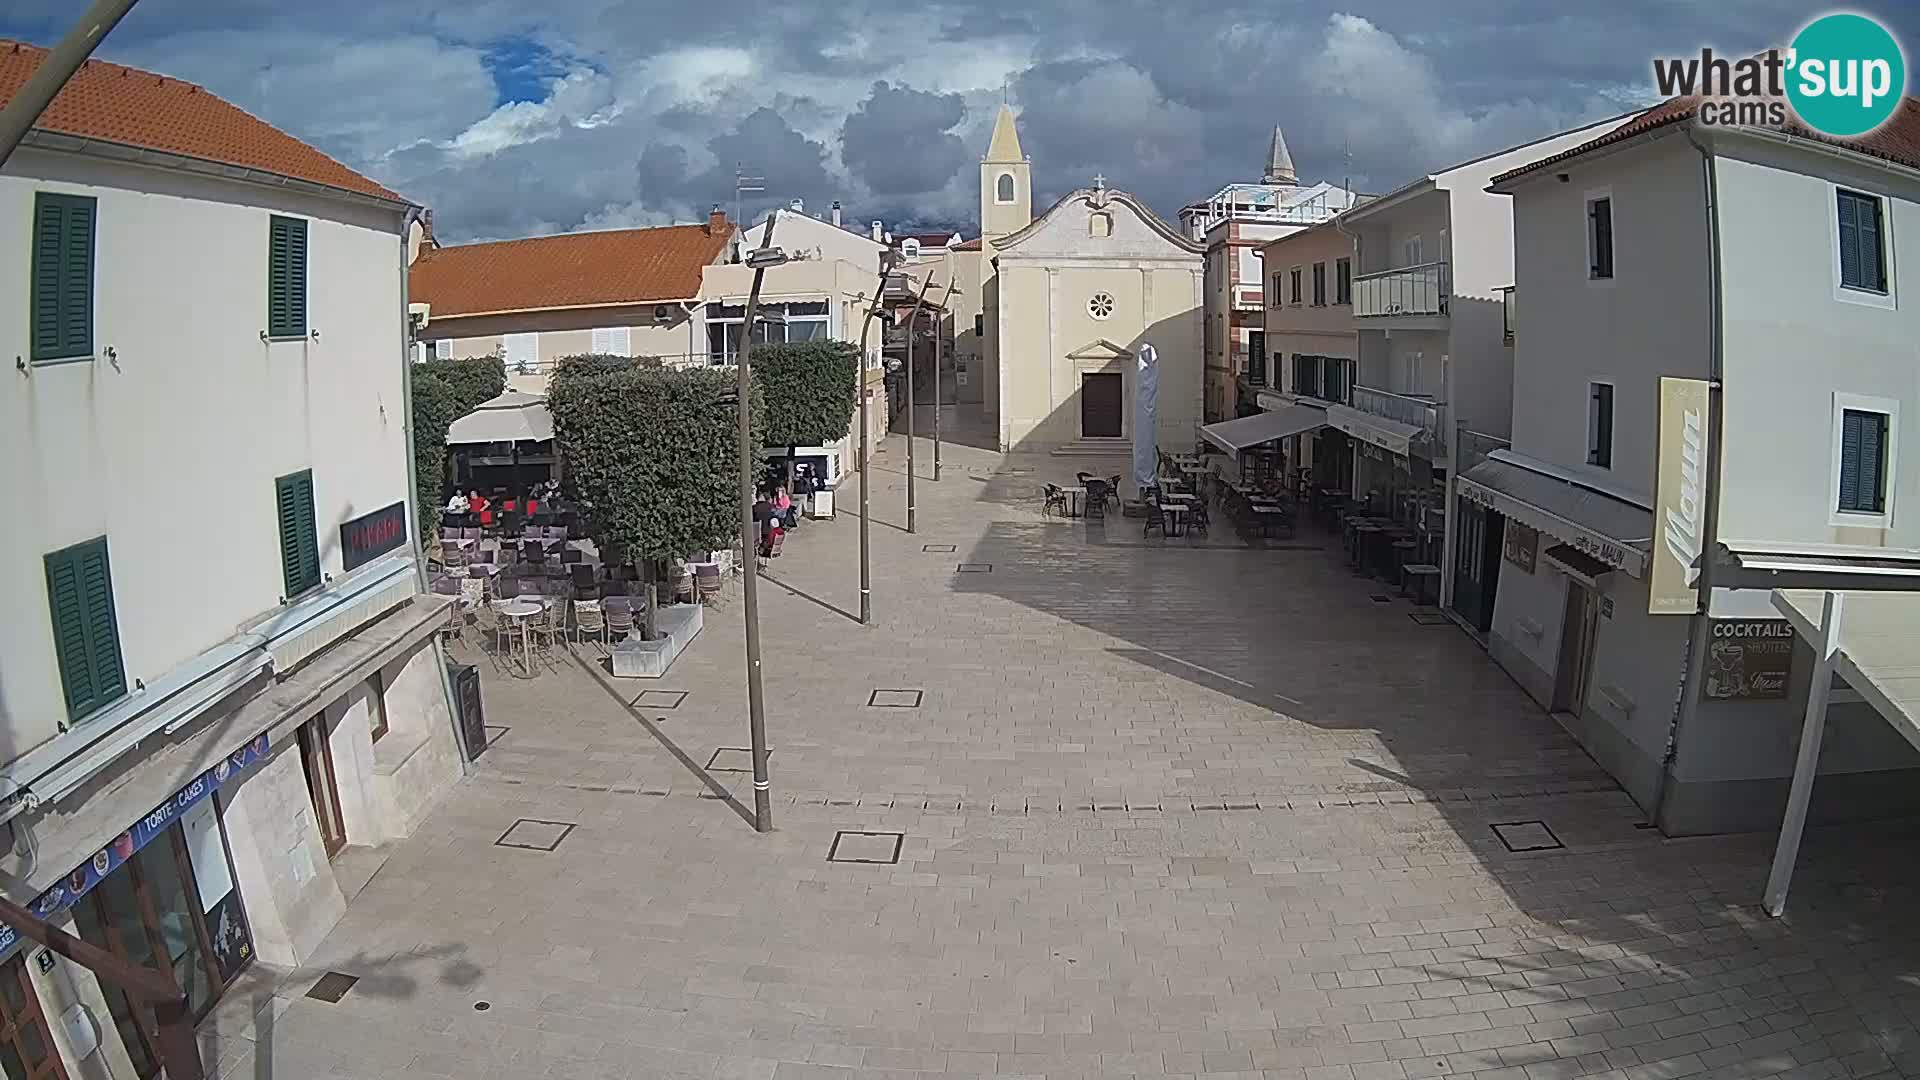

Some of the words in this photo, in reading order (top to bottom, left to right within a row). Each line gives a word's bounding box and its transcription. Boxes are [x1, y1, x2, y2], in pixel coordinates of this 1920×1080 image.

[1713, 623, 1793, 637] COCKTAILS
[144, 802, 173, 832] TORTE
[178, 778, 204, 807] CAKES
